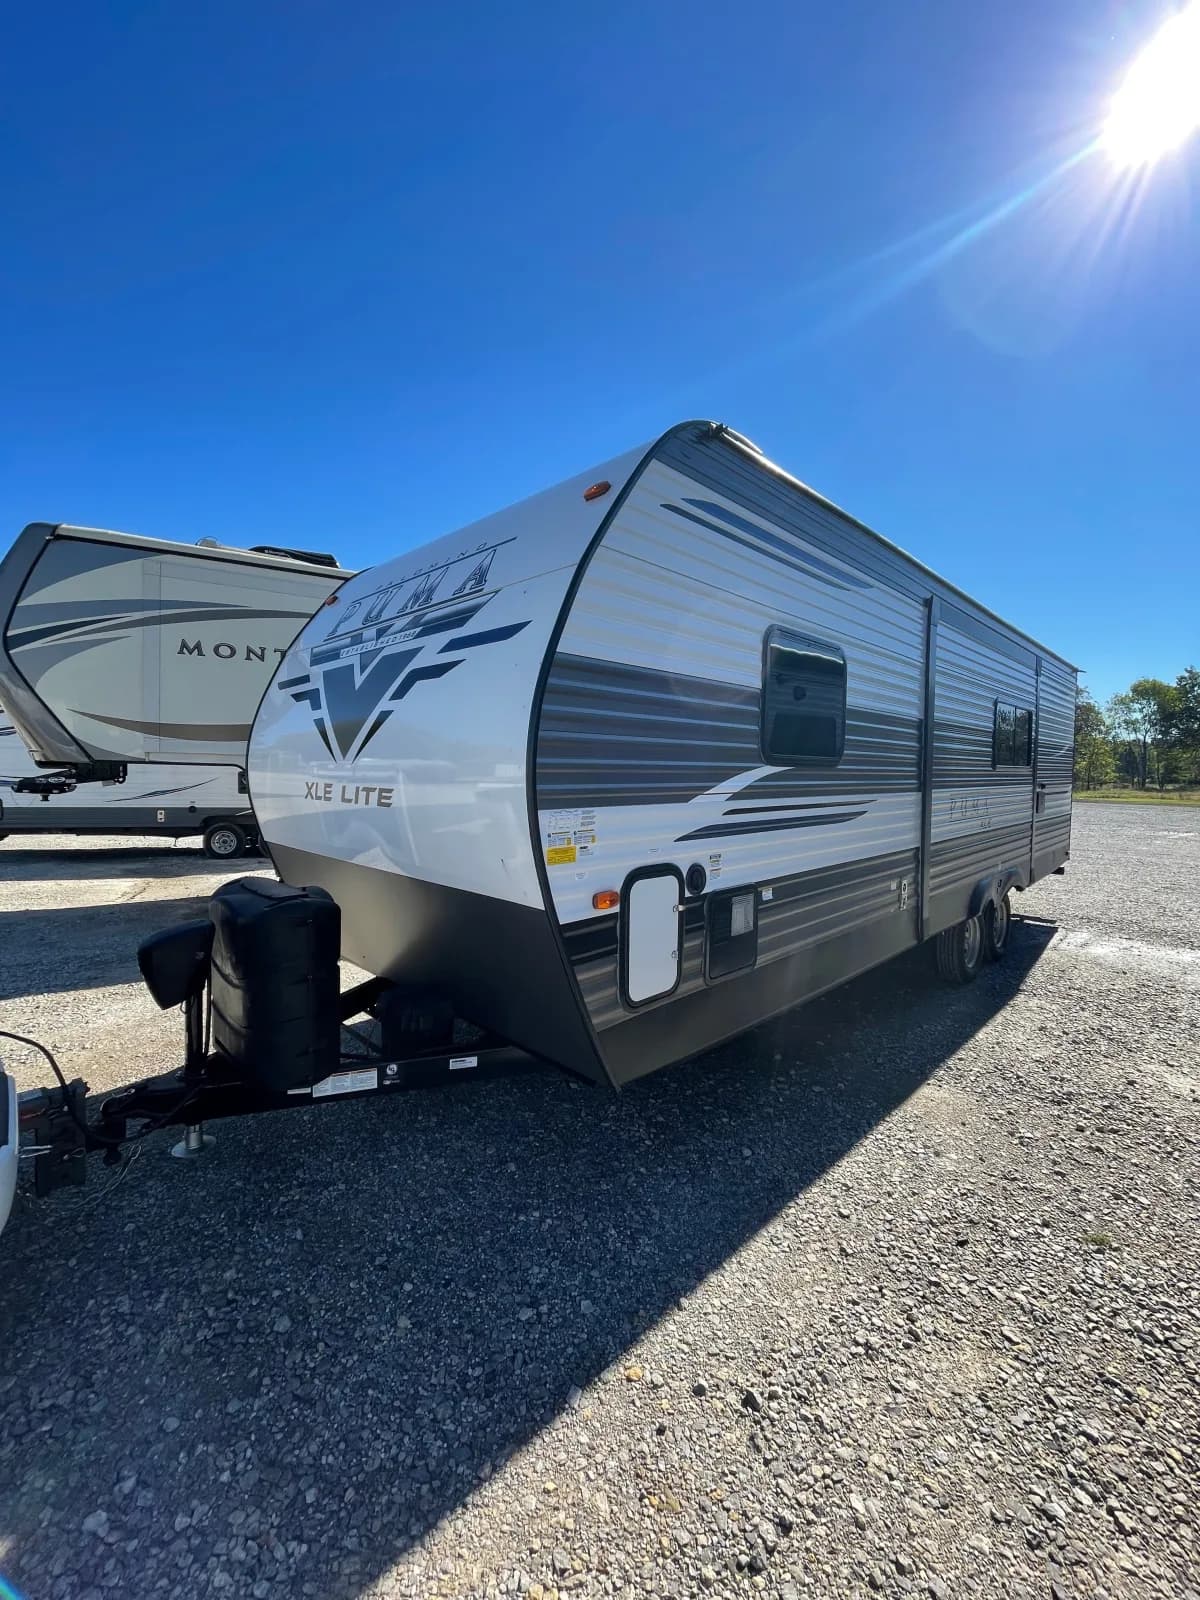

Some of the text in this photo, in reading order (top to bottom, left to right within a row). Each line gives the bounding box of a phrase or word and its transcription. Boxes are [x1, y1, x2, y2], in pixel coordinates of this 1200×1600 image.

[327, 548, 498, 638] PUMA
[304, 781, 395, 808] XLE LITE
